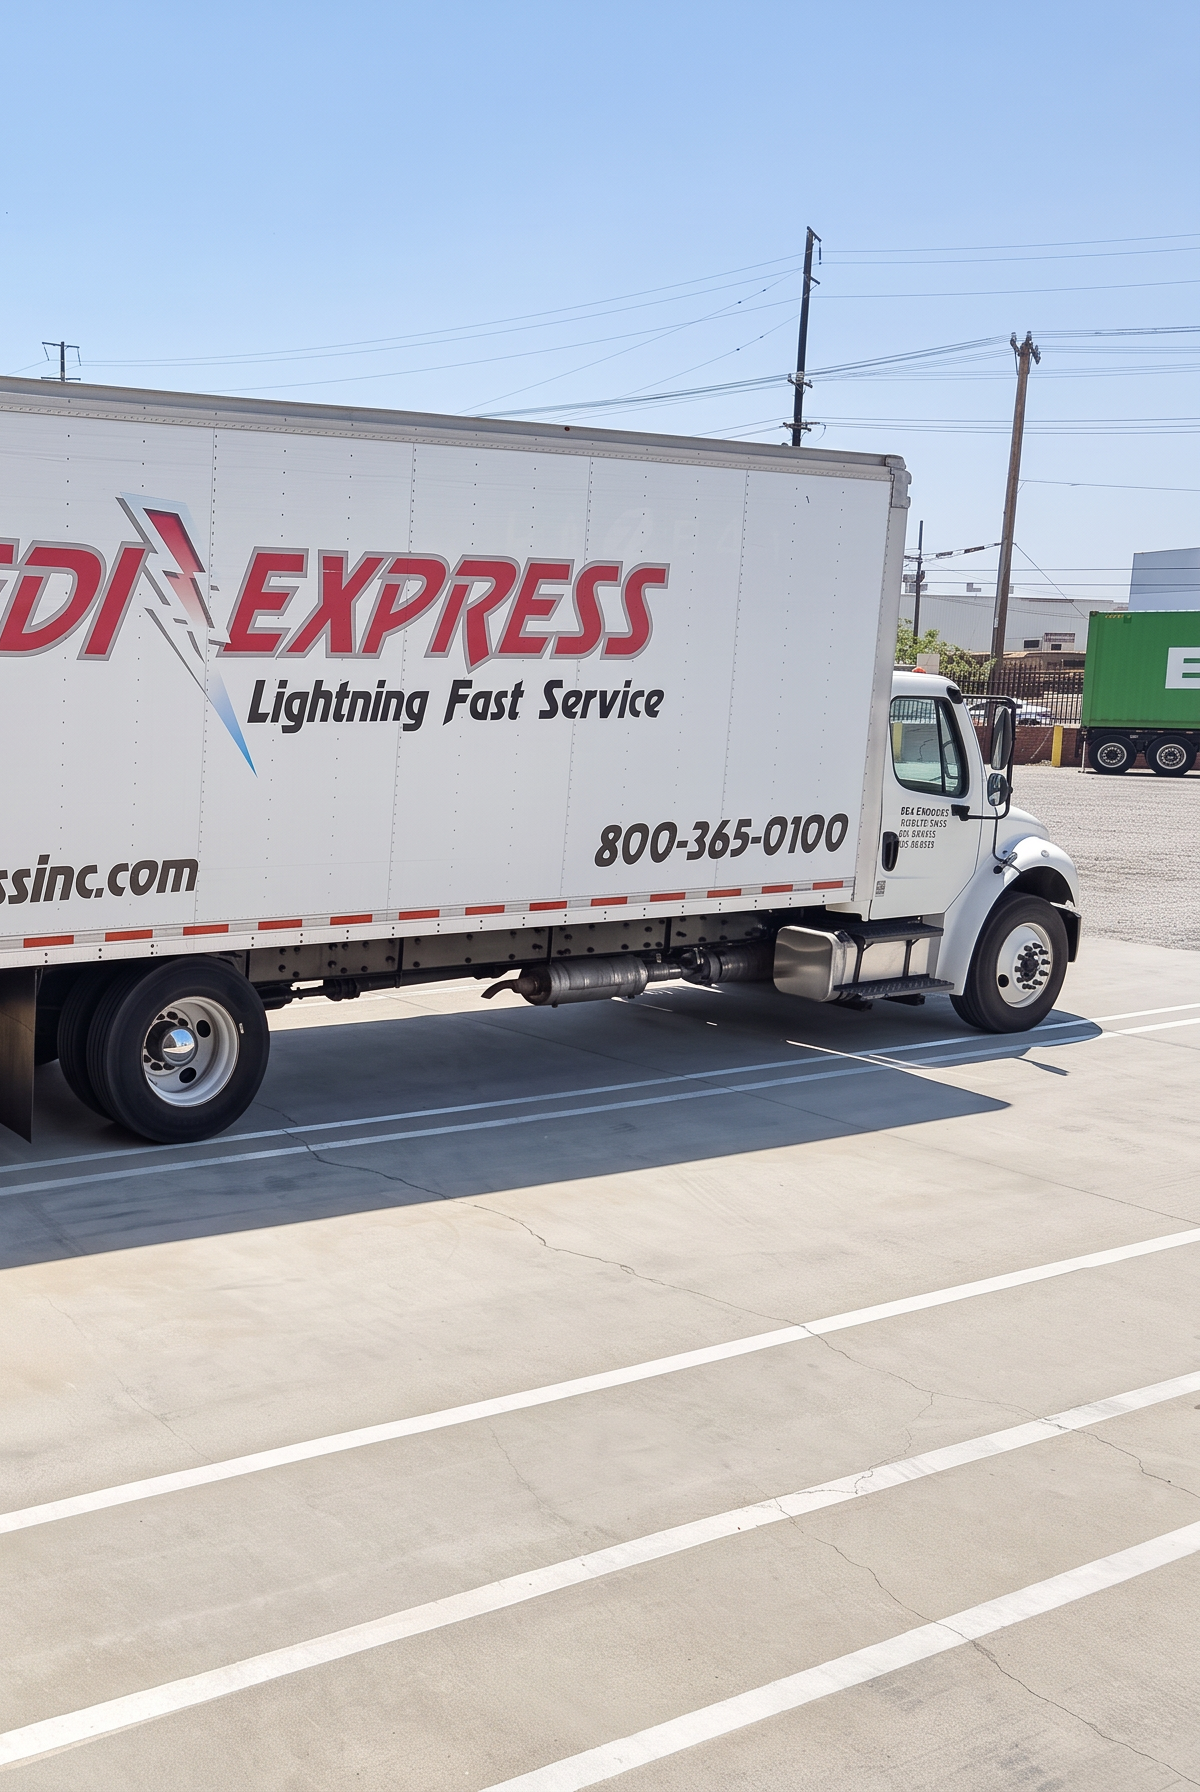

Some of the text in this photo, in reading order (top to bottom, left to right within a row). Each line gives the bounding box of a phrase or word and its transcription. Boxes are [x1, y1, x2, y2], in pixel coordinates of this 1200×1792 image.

[216, 546, 670, 674] EXPRESS
[247, 679, 665, 733] Lightning Fast Service
[594, 813, 849, 868] 800-365-0100
